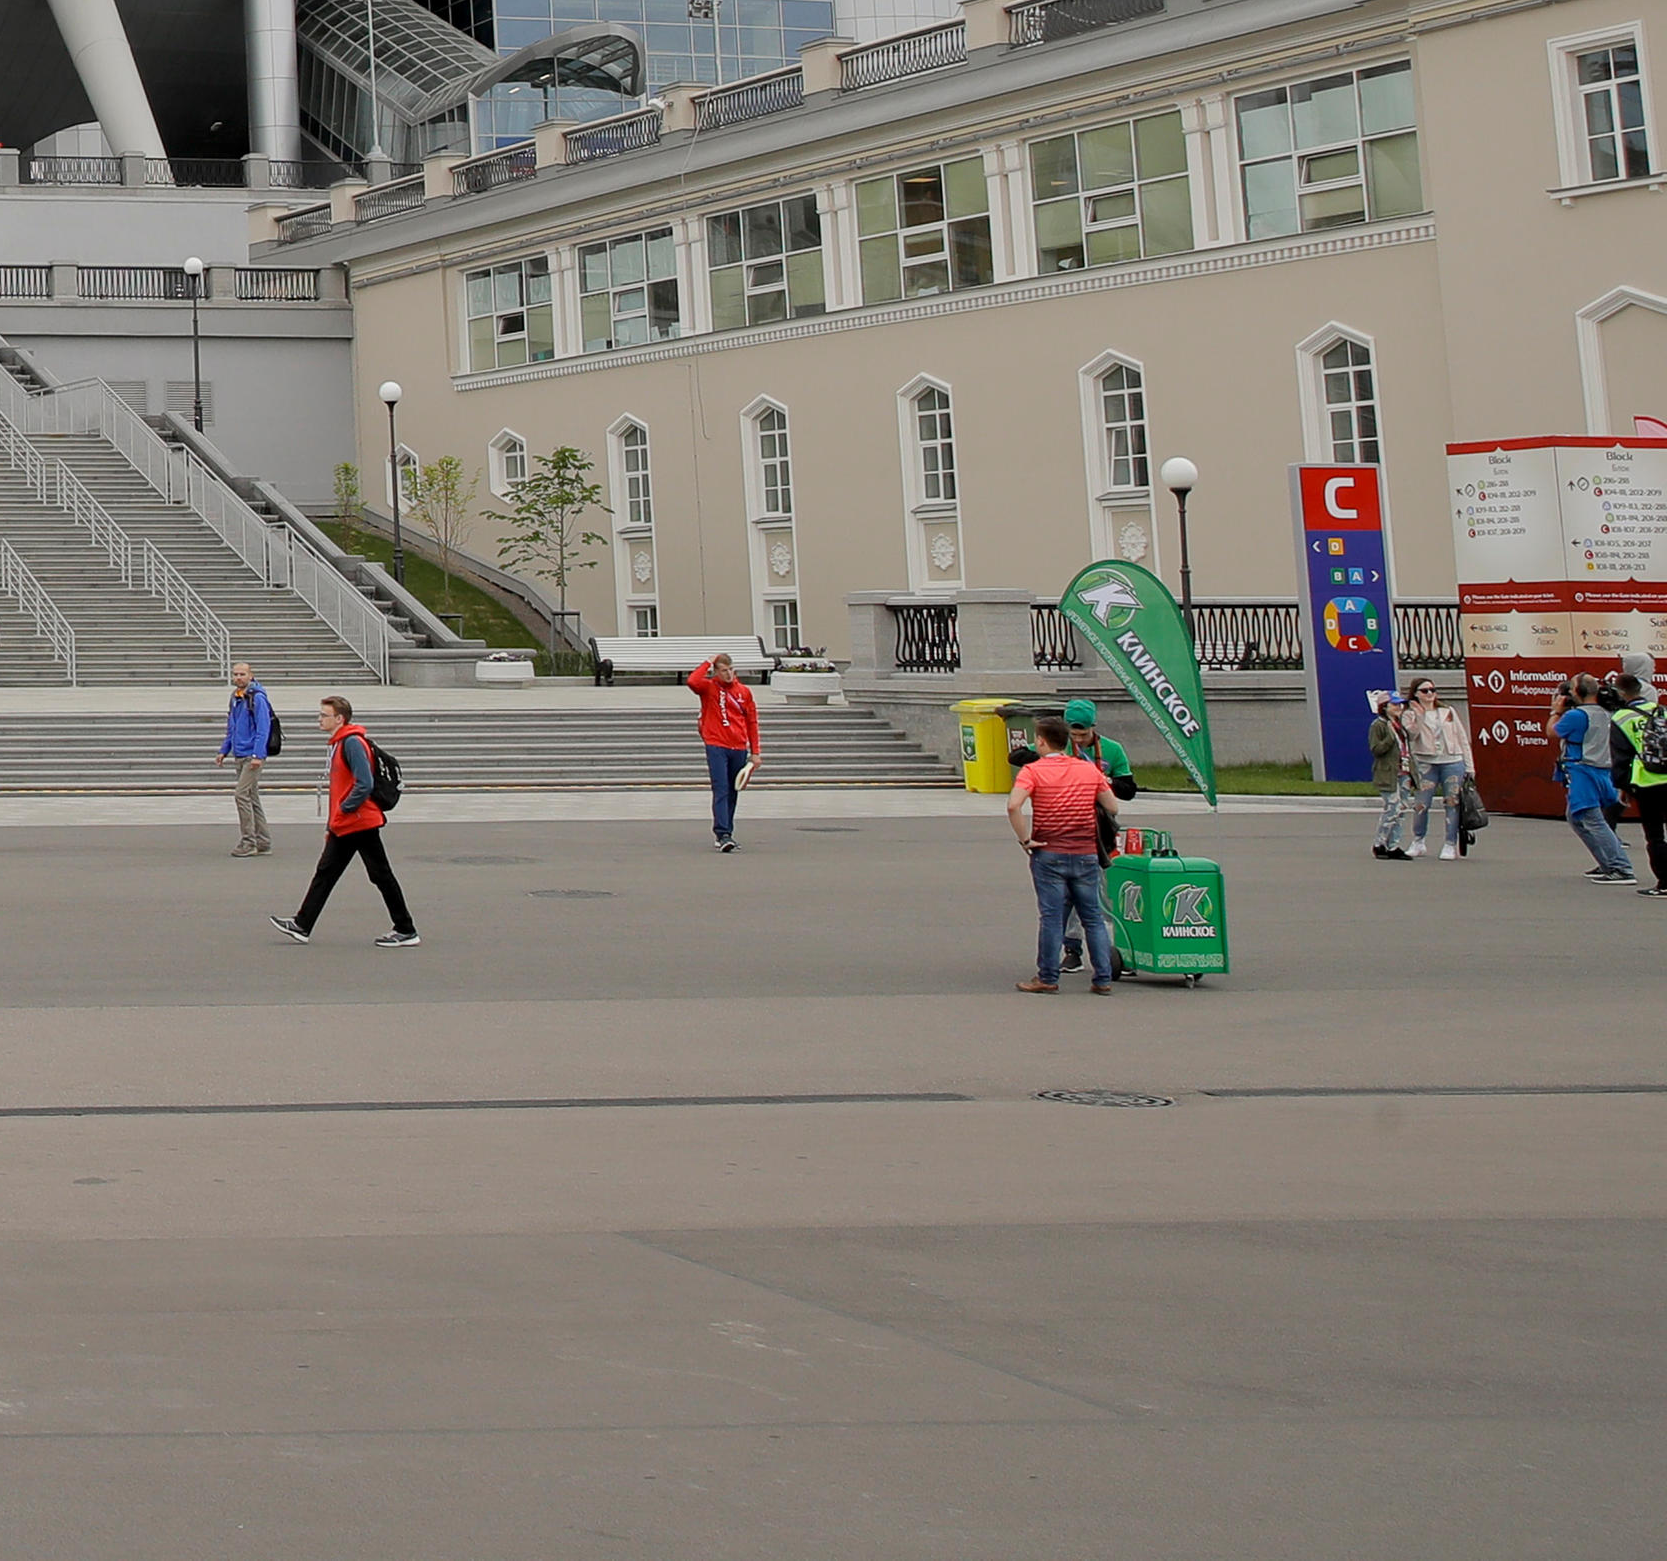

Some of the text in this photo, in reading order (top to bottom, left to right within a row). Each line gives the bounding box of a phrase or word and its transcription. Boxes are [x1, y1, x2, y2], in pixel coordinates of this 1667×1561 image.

[1606, 451, 1633, 461] Block
[1324, 477, 1358, 519] C
[1331, 542, 1340, 551] D
[1334, 572, 1362, 581] B A
[1344, 600, 1355, 611] A
[1326, 619, 1377, 629] D B
[1348, 638, 1358, 649] C
[1509, 670, 1567, 682] Information
[1116, 630, 1201, 738] КЛИНСКОЕ
[1514, 720, 1542, 732] Toilet
[1515, 735, 1548, 746] Туалеты
[1162, 926, 1216, 938] КЛИНСКОЕ
